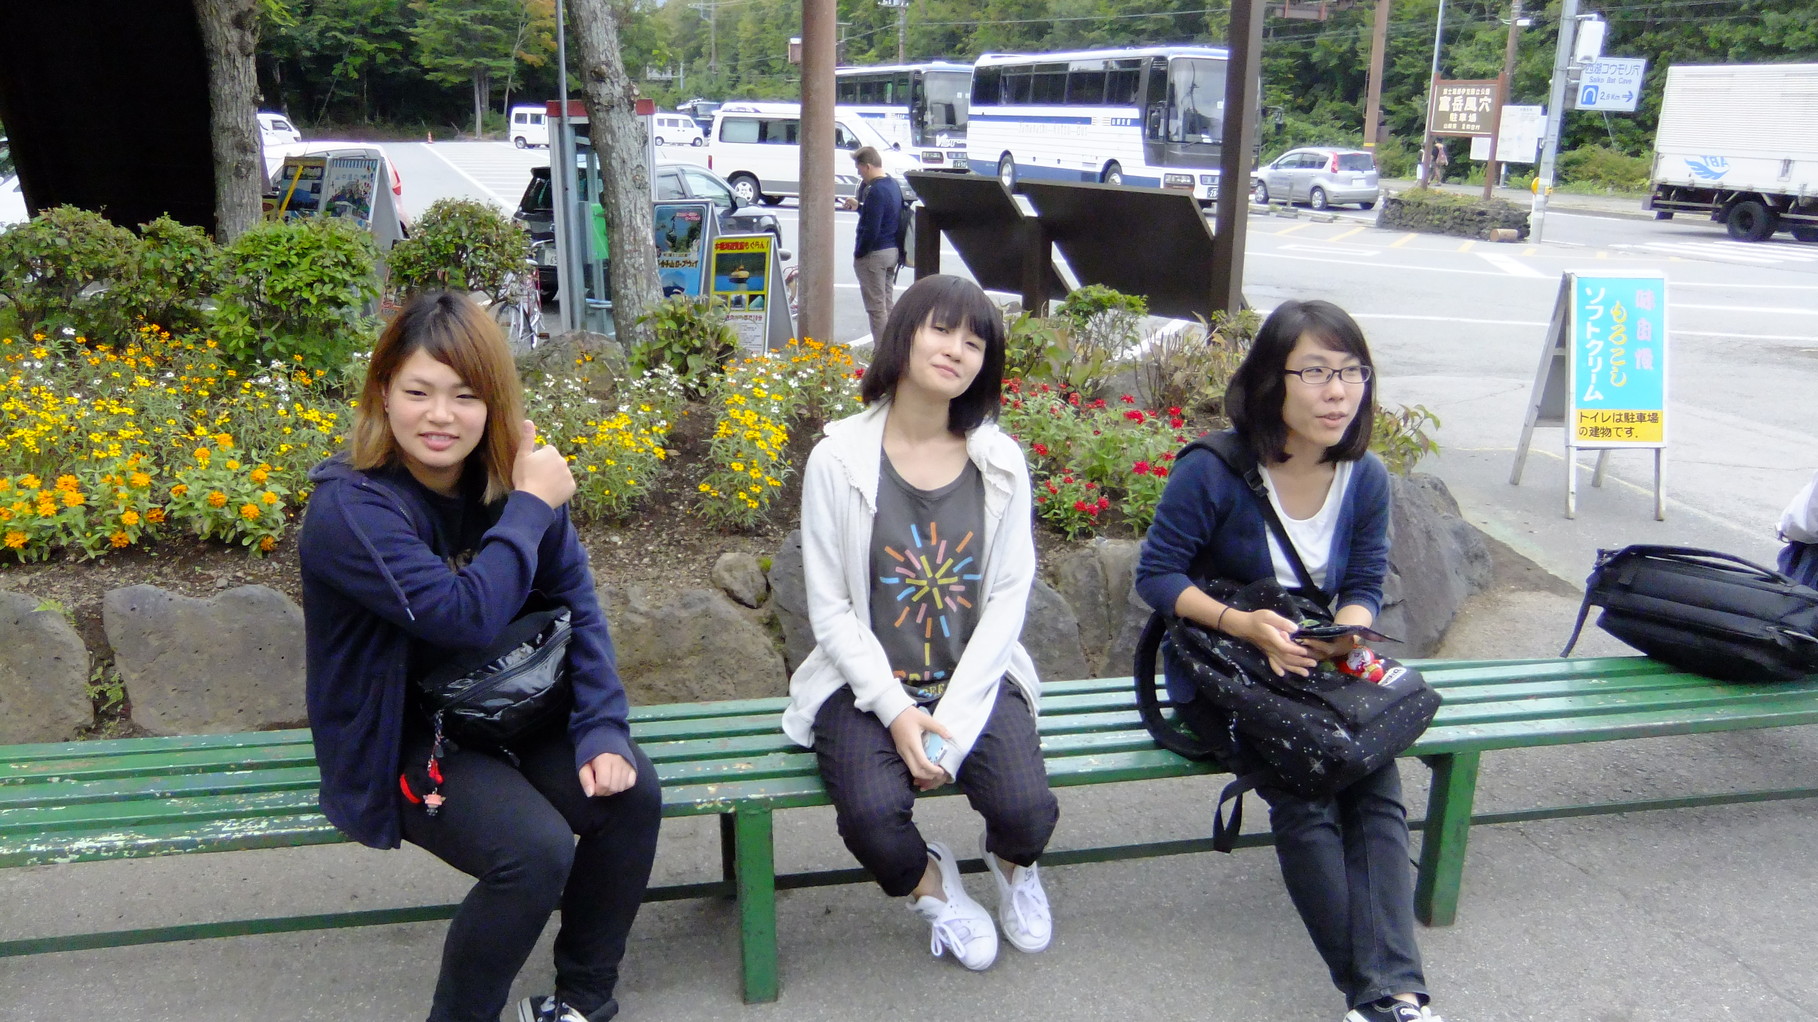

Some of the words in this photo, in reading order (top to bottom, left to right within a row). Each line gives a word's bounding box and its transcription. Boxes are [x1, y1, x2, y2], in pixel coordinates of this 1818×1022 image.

[1438, 95, 1492, 112] 富岳風穴
[1449, 112, 1477, 122] 駐車場
[1584, 288, 1605, 402] ソフトクリーム
[1609, 301, 1627, 387] もろこし
[1580, 412, 1659, 424] トイレは駐車場
